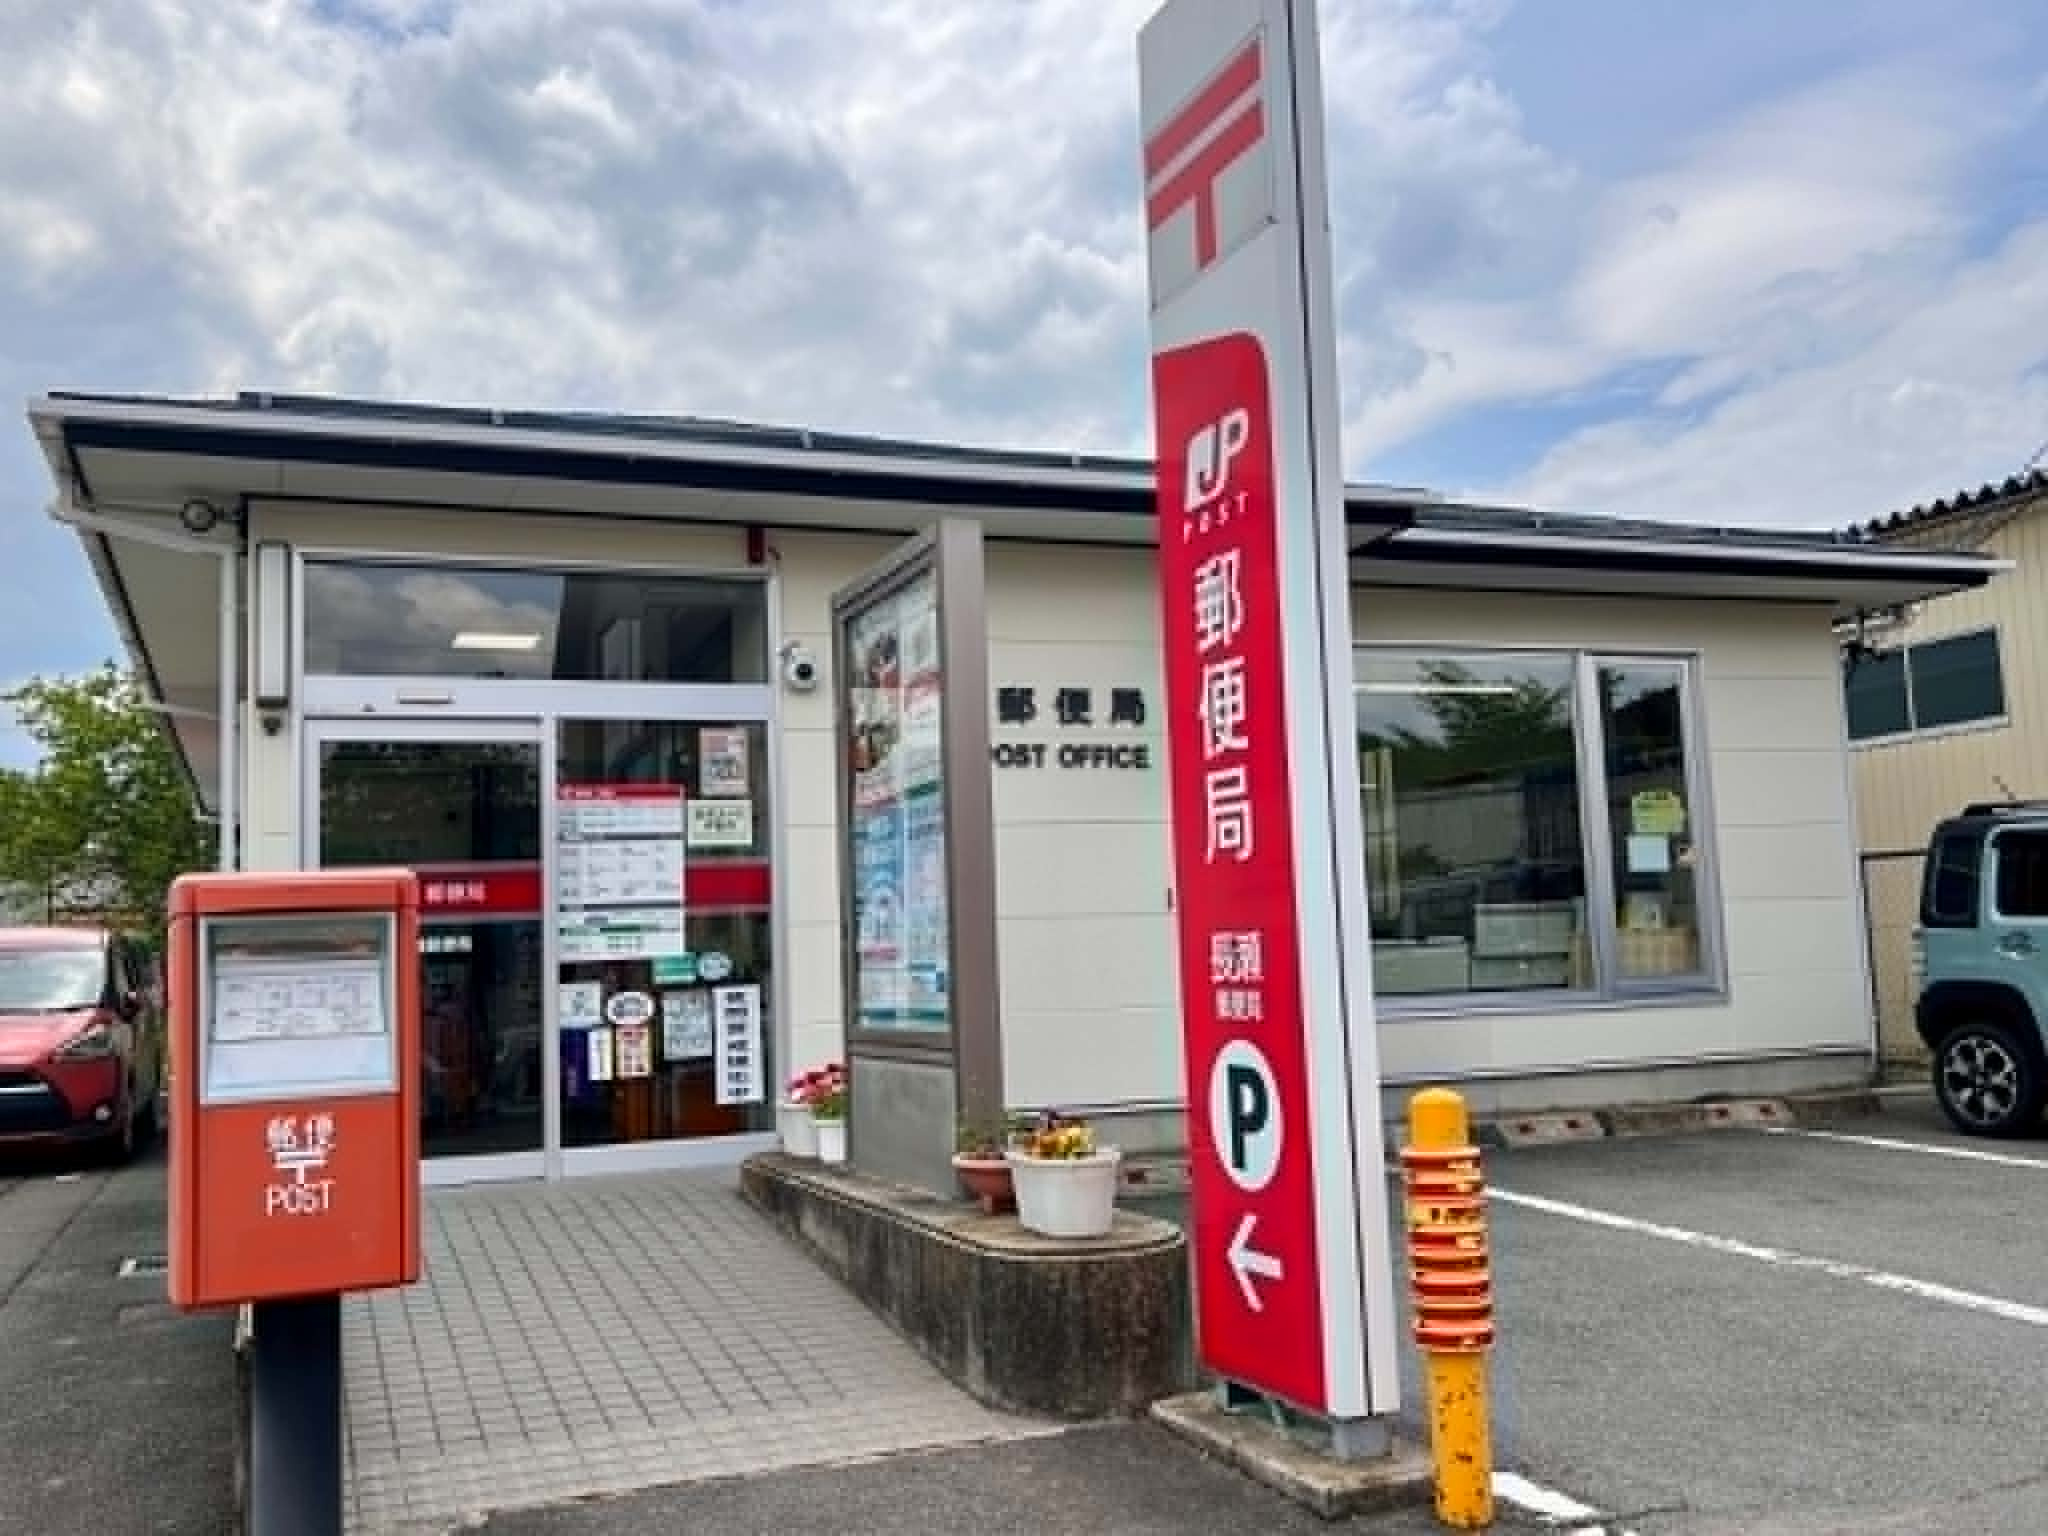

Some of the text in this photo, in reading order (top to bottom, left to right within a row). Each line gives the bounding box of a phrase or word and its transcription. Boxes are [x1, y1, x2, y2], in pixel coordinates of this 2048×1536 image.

[996, 686, 1146, 726] 郵便局
[1192, 546, 1254, 864] 郵便局
[986, 743, 1153, 769] OST OFFICE
[264, 1112, 337, 1152] 郵便
[1226, 1062, 1269, 1171] P
[263, 1177, 337, 1217] POST
